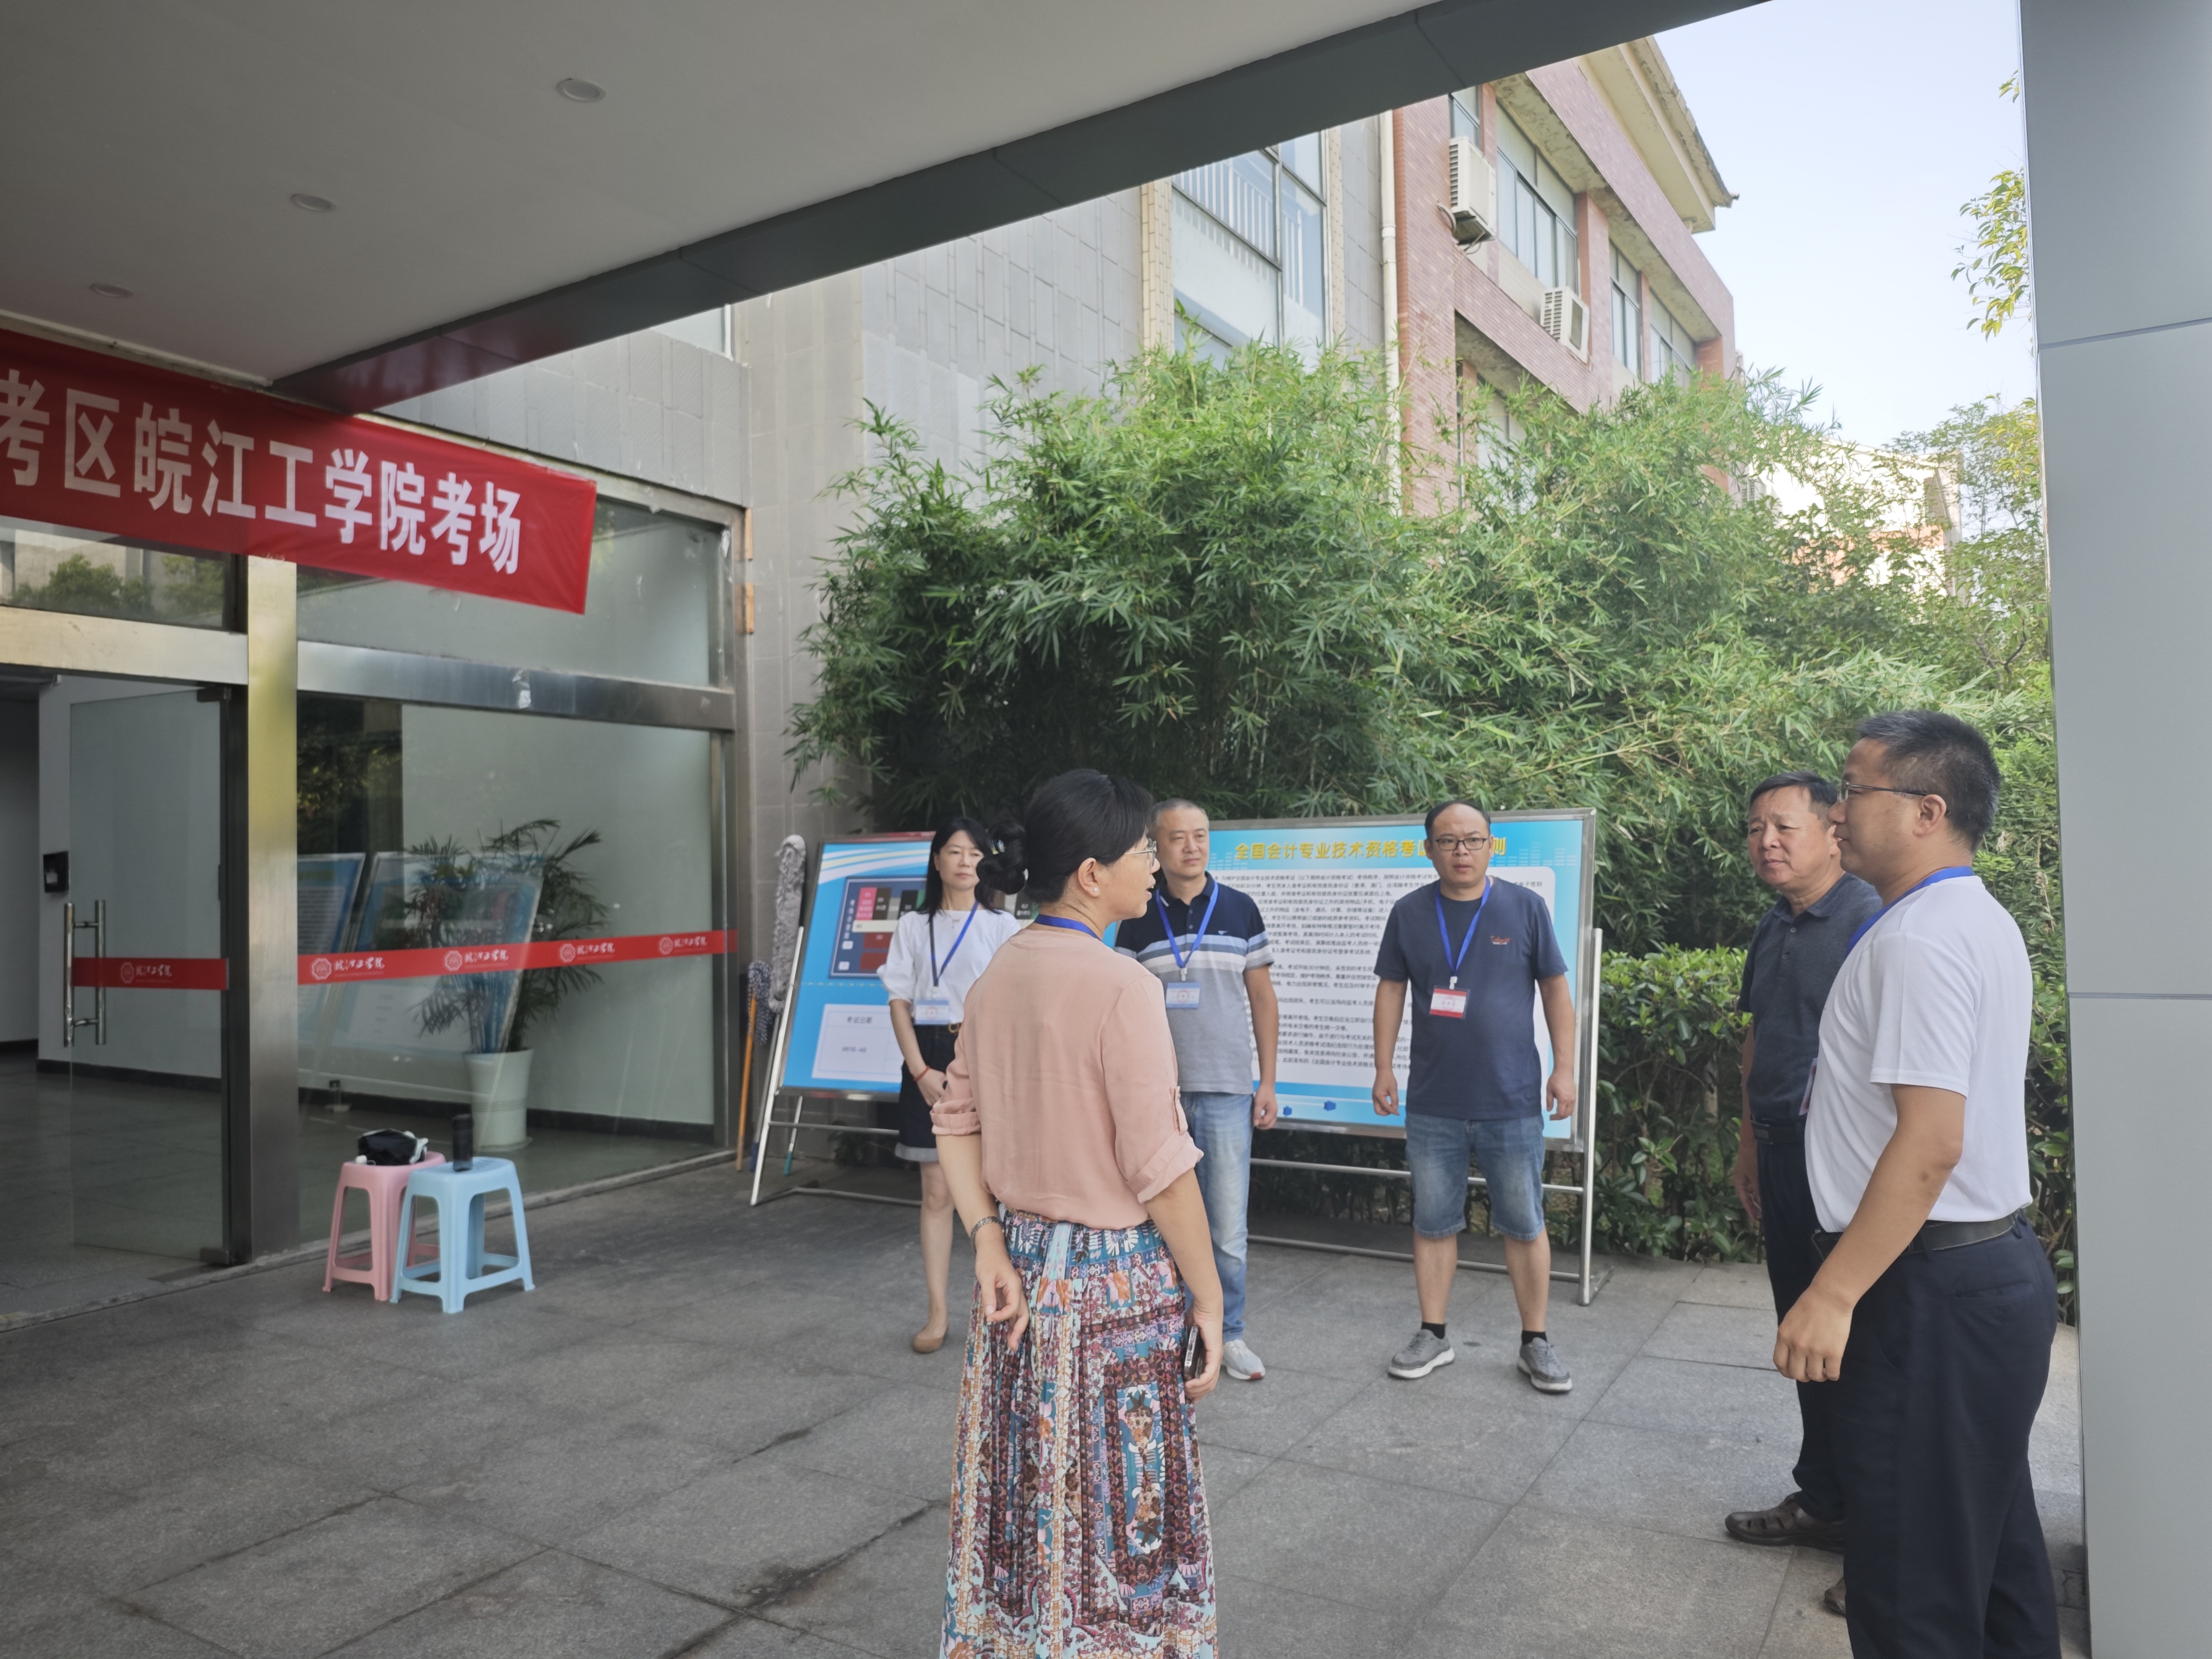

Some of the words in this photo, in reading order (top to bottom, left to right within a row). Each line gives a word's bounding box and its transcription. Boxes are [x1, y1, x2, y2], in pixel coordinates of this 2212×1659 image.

[0, 369, 521, 575] 考区皖江工学院考场
